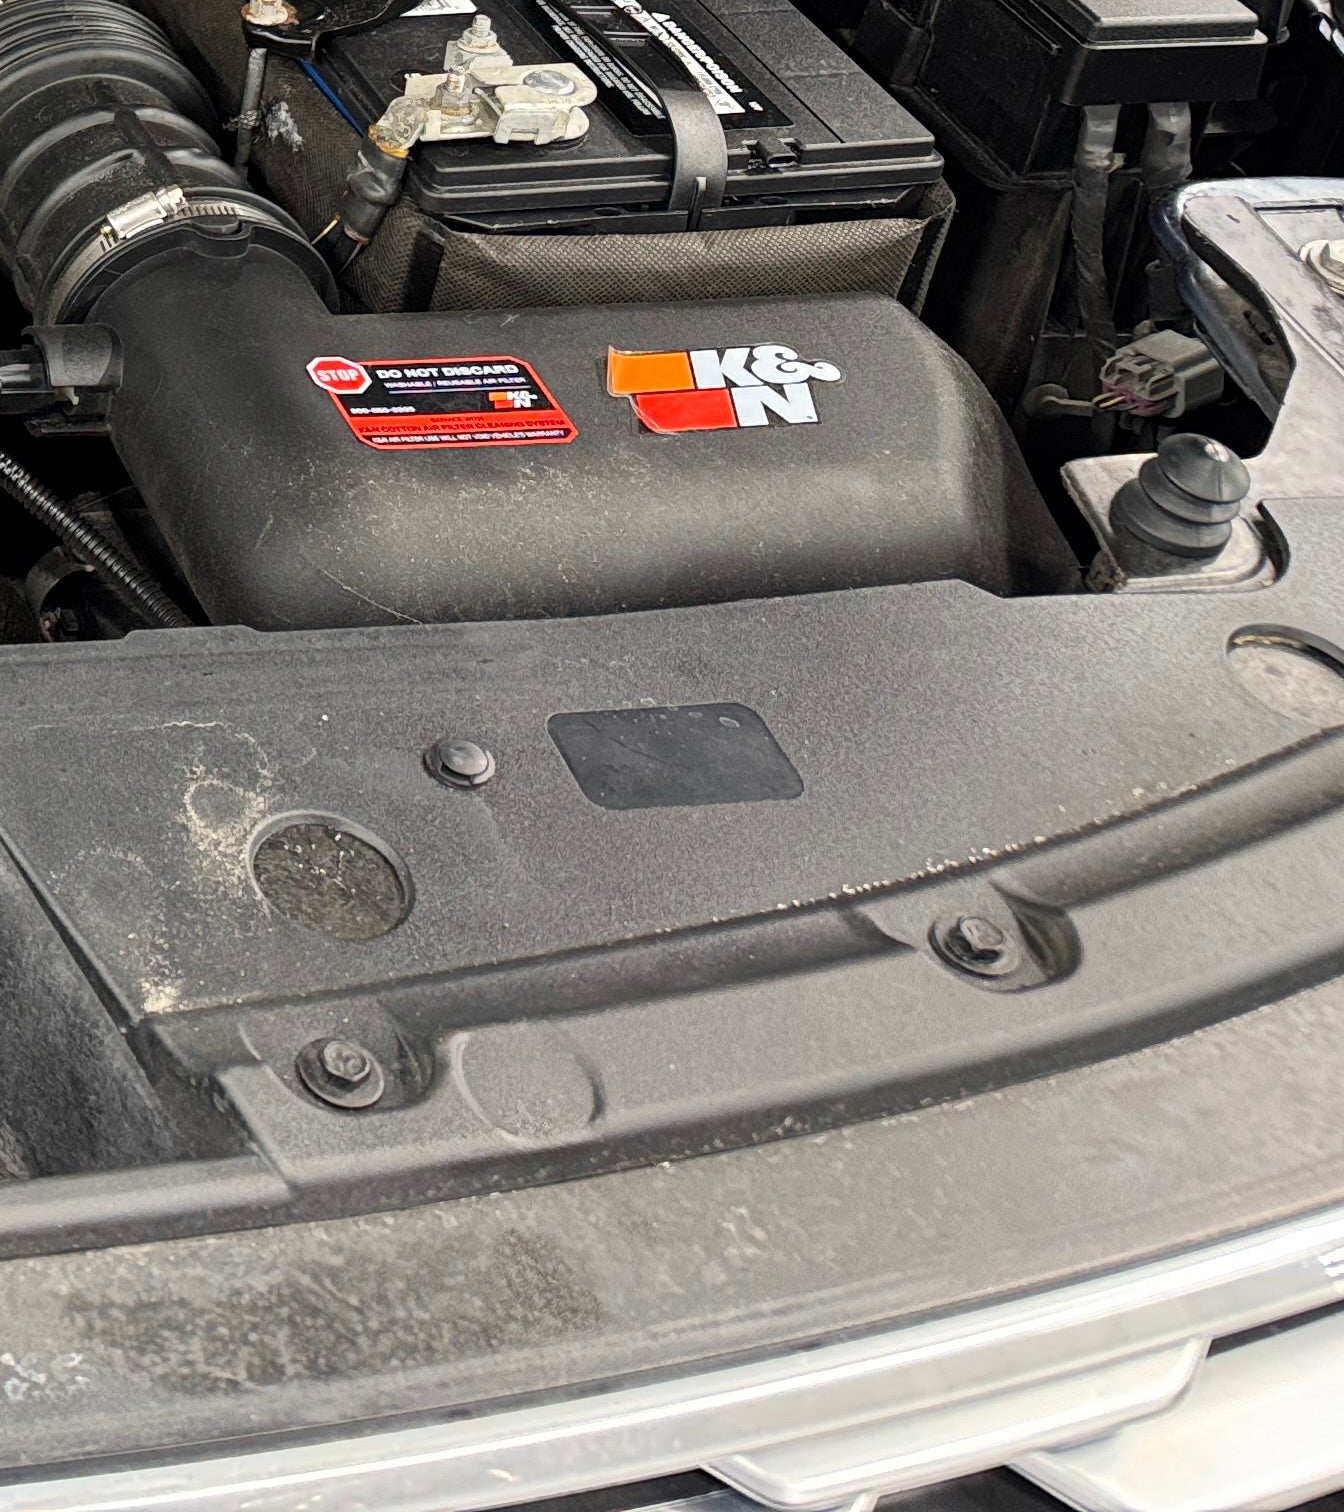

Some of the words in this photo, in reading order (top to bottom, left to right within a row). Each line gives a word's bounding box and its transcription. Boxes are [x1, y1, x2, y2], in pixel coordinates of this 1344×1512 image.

[317, 369, 359, 382] STOP
[375, 369, 402, 380] DO
[404, 367, 439, 378] NOT
[441, 364, 519, 377] DISCARD
